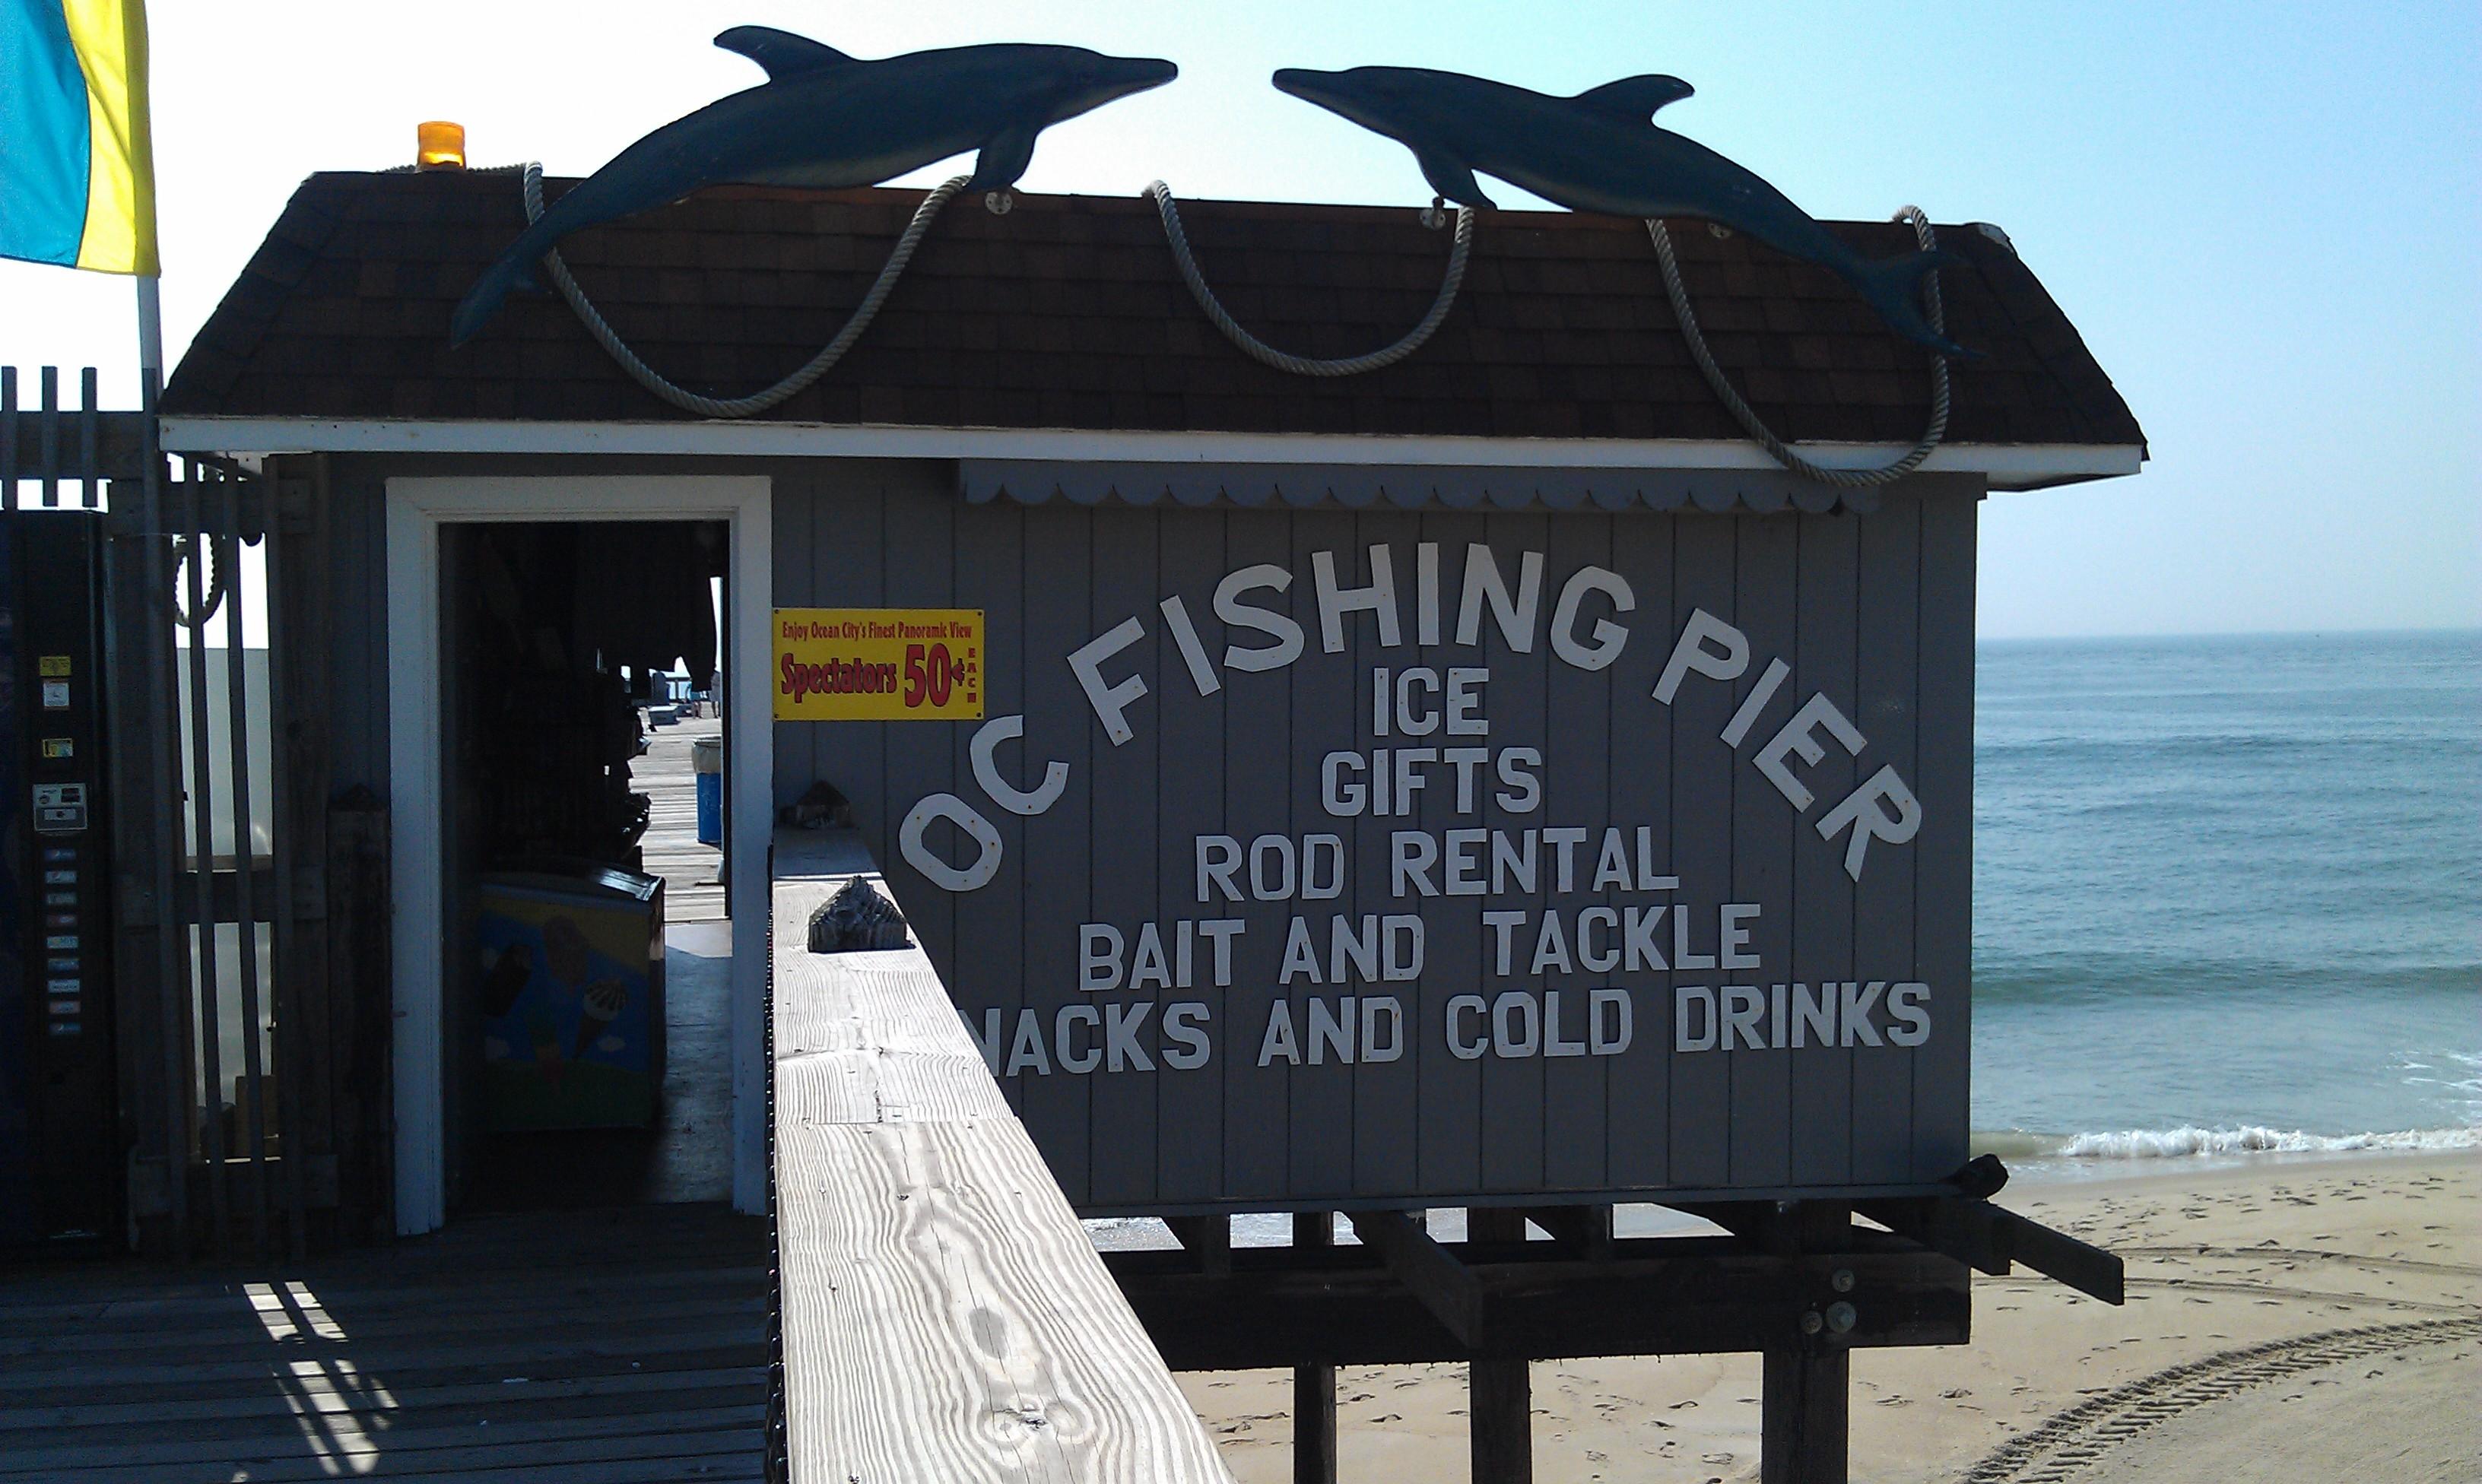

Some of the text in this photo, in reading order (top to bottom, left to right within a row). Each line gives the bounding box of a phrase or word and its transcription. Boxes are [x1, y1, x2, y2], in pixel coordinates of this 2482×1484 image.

[782, 620, 972, 642] Enjoy Ocean City's Finest Panoramic View
[781, 652, 897, 703] Spectators
[1373, 667, 1489, 736] ICE
[900, 543, 1922, 891] OC FISHING PIER
[1322, 747, 1541, 817] GIFTS
[1196, 827, 1679, 902] ROD RENTAL
[1080, 903, 1760, 991] BAIT AND TACKLE
[957, 981, 1931, 1077] NACKS AND COLD DRINKS
